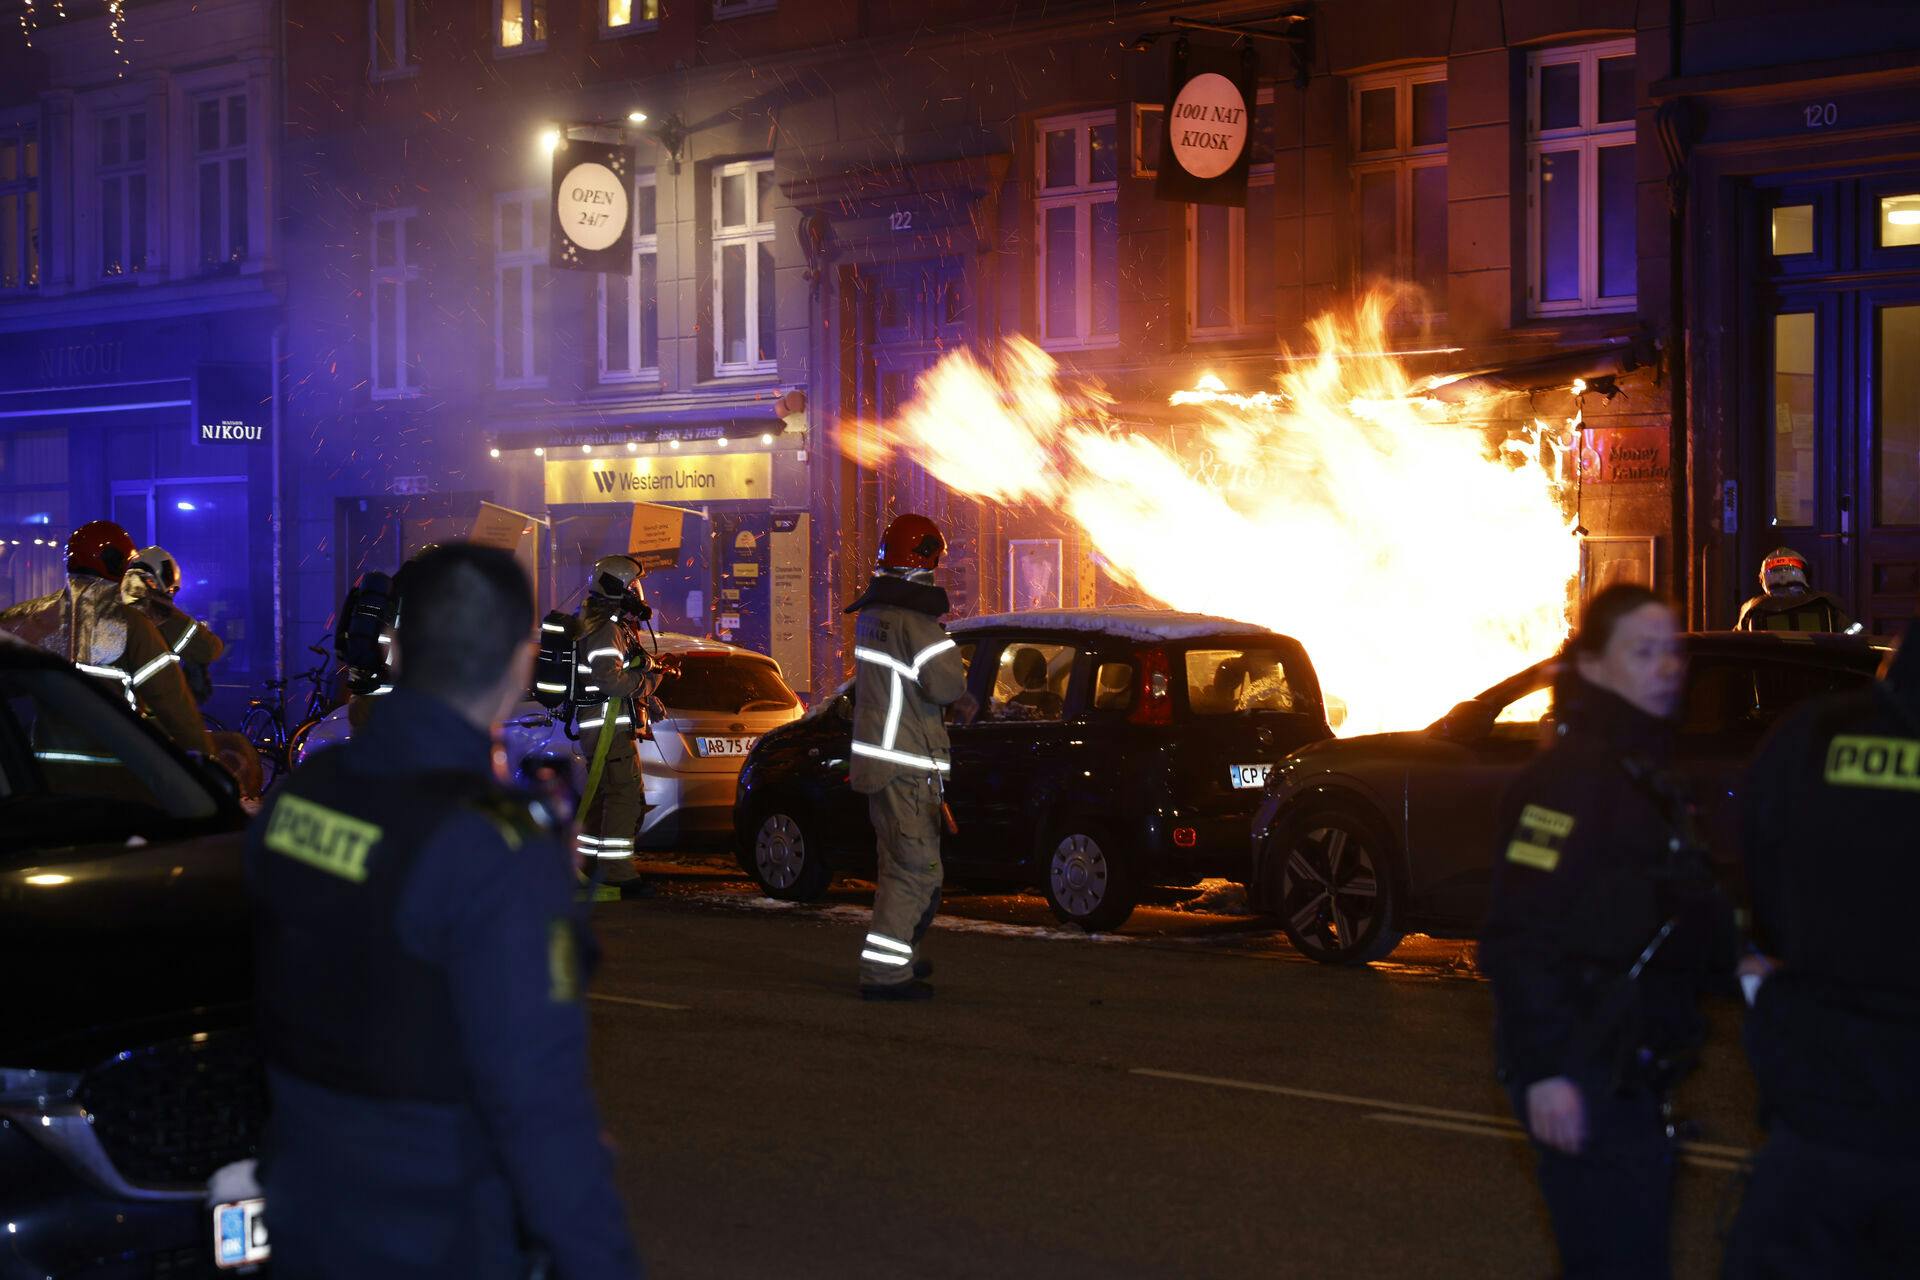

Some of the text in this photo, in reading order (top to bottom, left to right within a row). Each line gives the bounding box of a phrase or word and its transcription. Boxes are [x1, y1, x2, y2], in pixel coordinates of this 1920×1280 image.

[1175, 103, 1244, 124] 1001 NAT
[1803, 103, 1837, 128] 120
[1181, 131, 1233, 151] KIOSK
[571, 187, 615, 205] OPEN
[577, 211, 610, 228] 24/7
[889, 211, 912, 231] 122
[40, 341, 124, 379] NIKOUI
[202, 425, 262, 440] NIKOUI
[619, 472, 673, 492] Western
[675, 470, 715, 490] Union
[708, 740, 725, 753] AB
[726, 740, 743, 753] 75
[1241, 768, 1258, 784] CP
